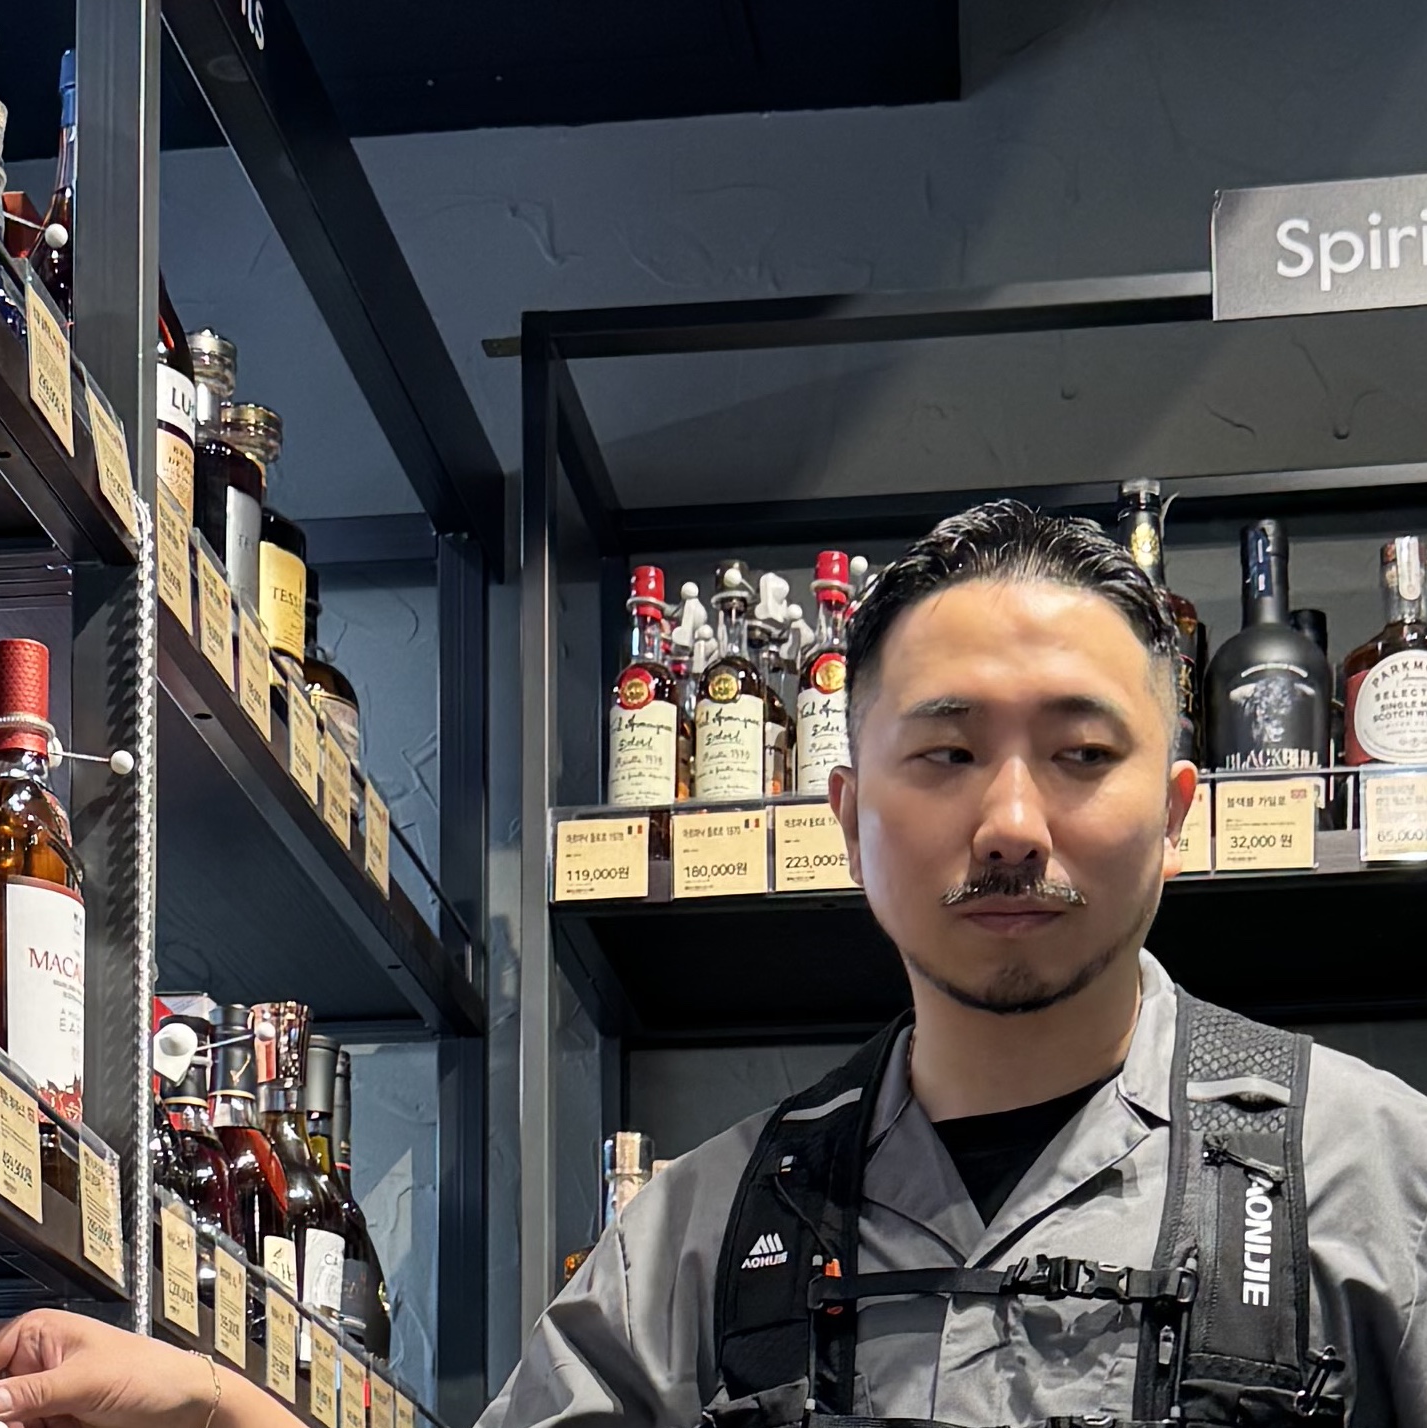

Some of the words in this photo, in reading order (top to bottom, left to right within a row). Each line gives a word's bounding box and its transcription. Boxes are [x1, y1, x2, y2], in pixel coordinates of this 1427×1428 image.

[1380, 699, 1419, 711] SINGLE
[1372, 709, 1415, 722] SCOTCH
[1230, 834, 1276, 849] 32,000
[1279, 833, 1293, 849] 원
